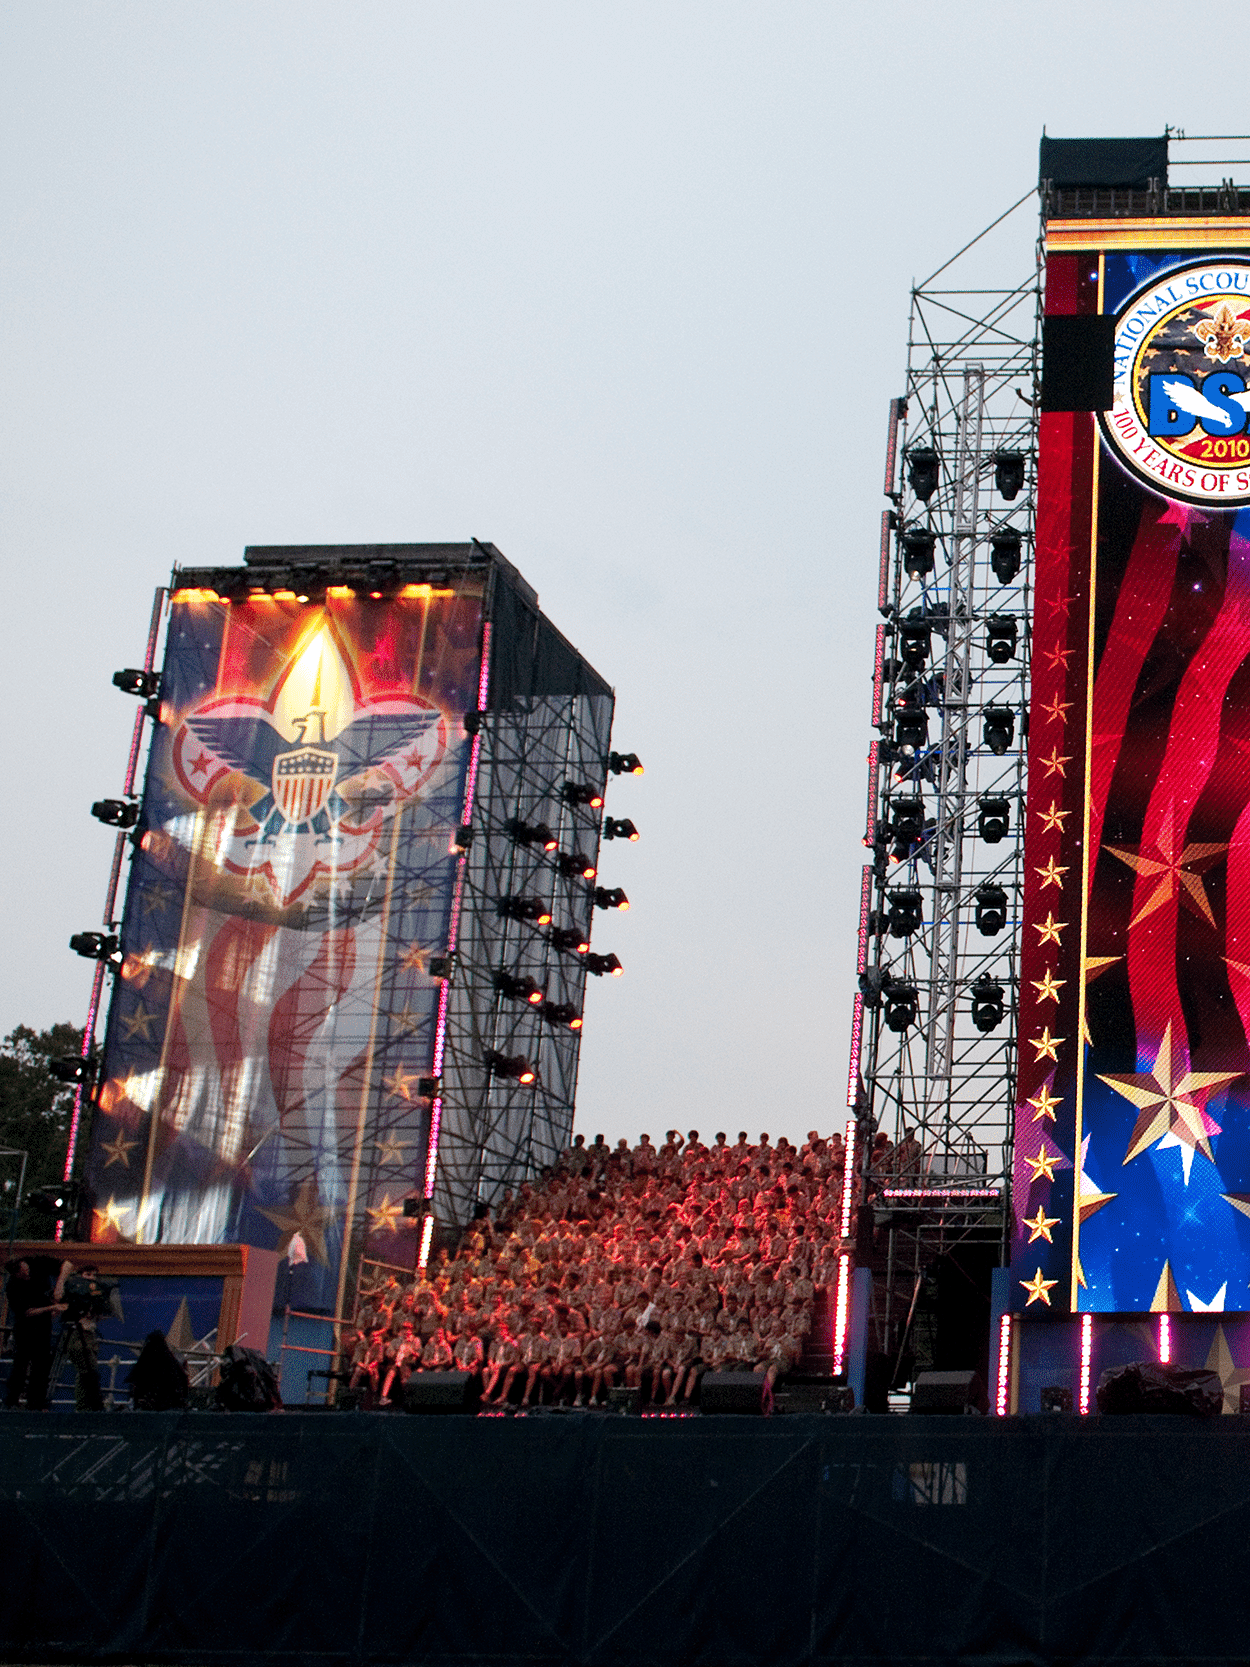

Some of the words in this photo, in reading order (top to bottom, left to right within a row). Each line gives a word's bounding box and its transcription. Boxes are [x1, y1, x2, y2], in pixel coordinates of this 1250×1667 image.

[1113, 286, 1184, 385] NATIONAL
[1112, 407, 1139, 440] 100
[1132, 437, 1197, 488] YEARS
[1200, 473, 1230, 492] OF
[1200, 439, 1250, 458] 2010
